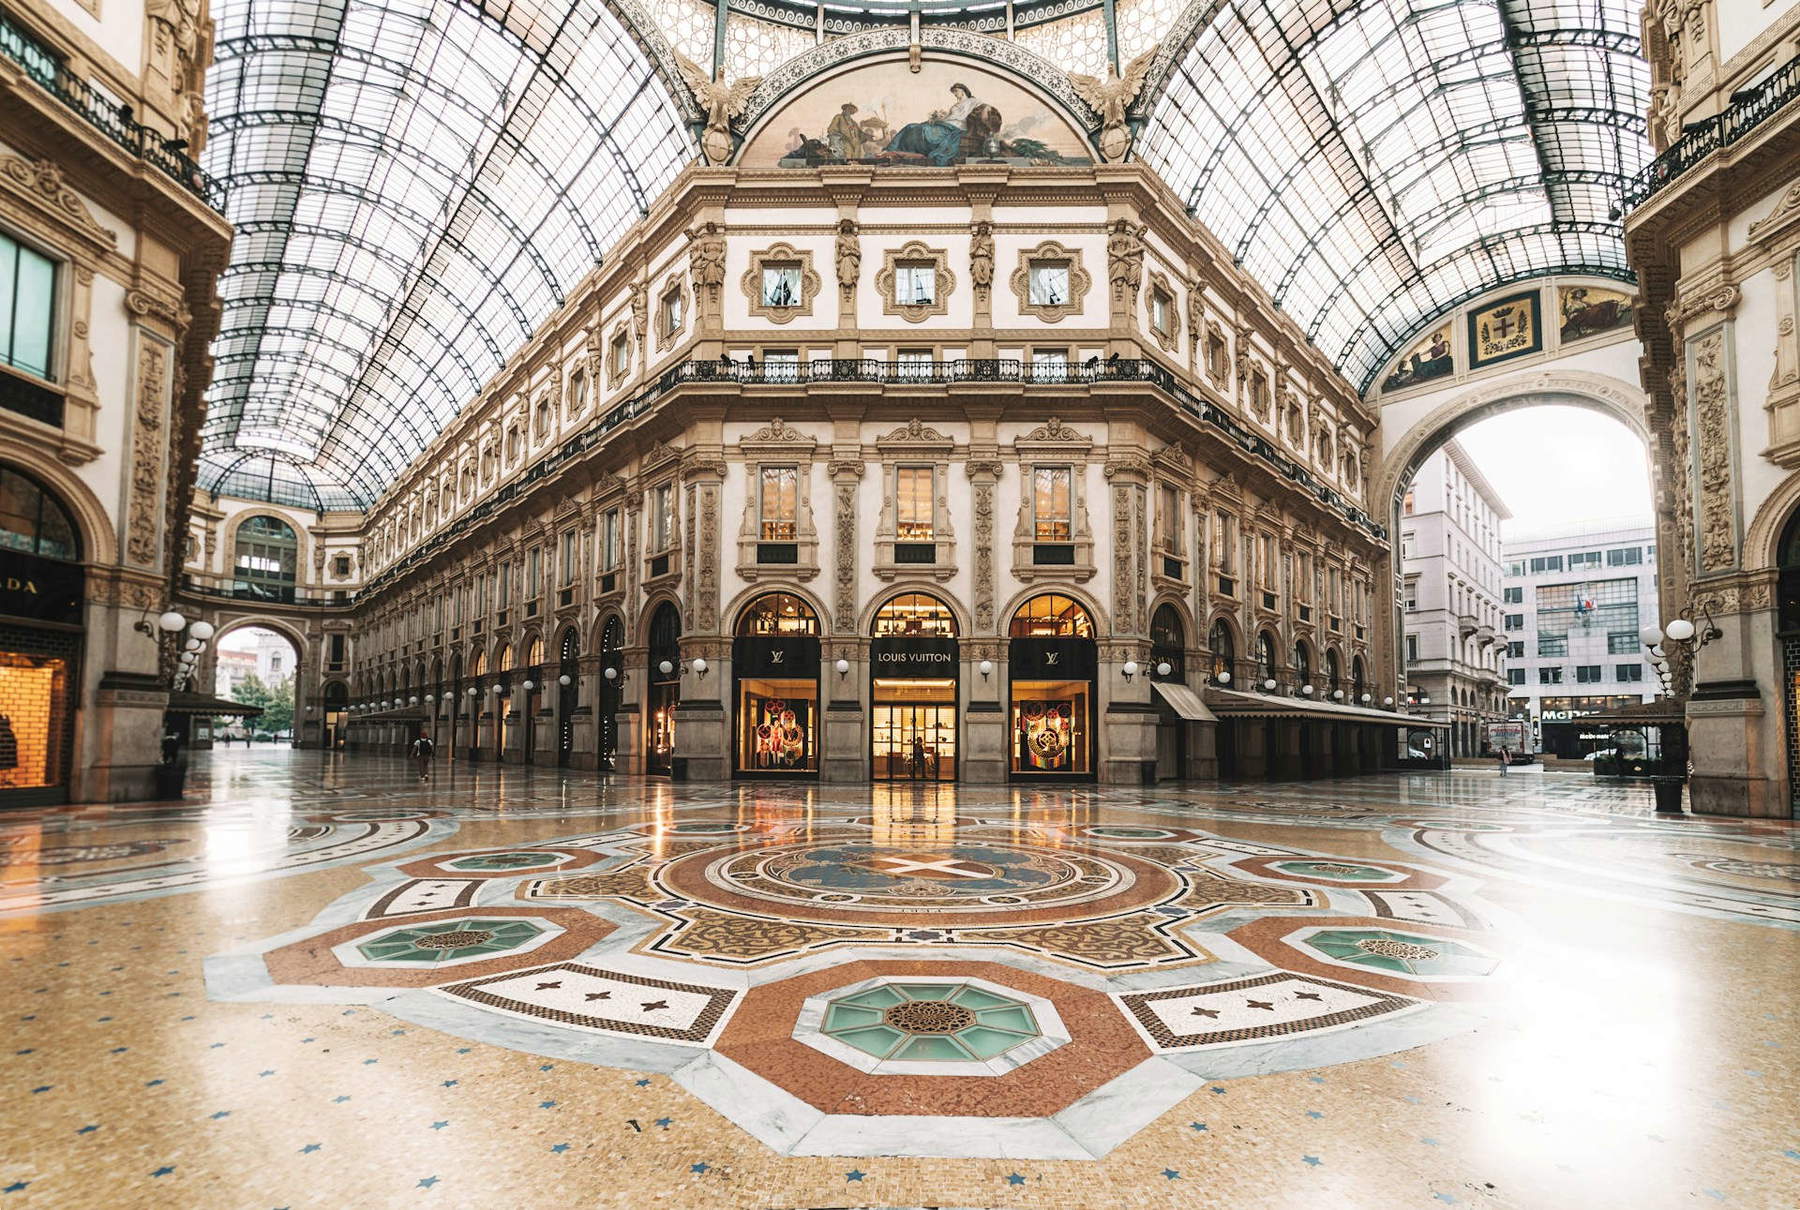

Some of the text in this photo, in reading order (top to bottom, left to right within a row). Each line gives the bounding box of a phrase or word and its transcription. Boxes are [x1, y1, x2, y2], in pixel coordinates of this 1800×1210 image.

[0, 578, 38, 594] DA
[878, 652, 952, 662] LOUIS VUITTON
